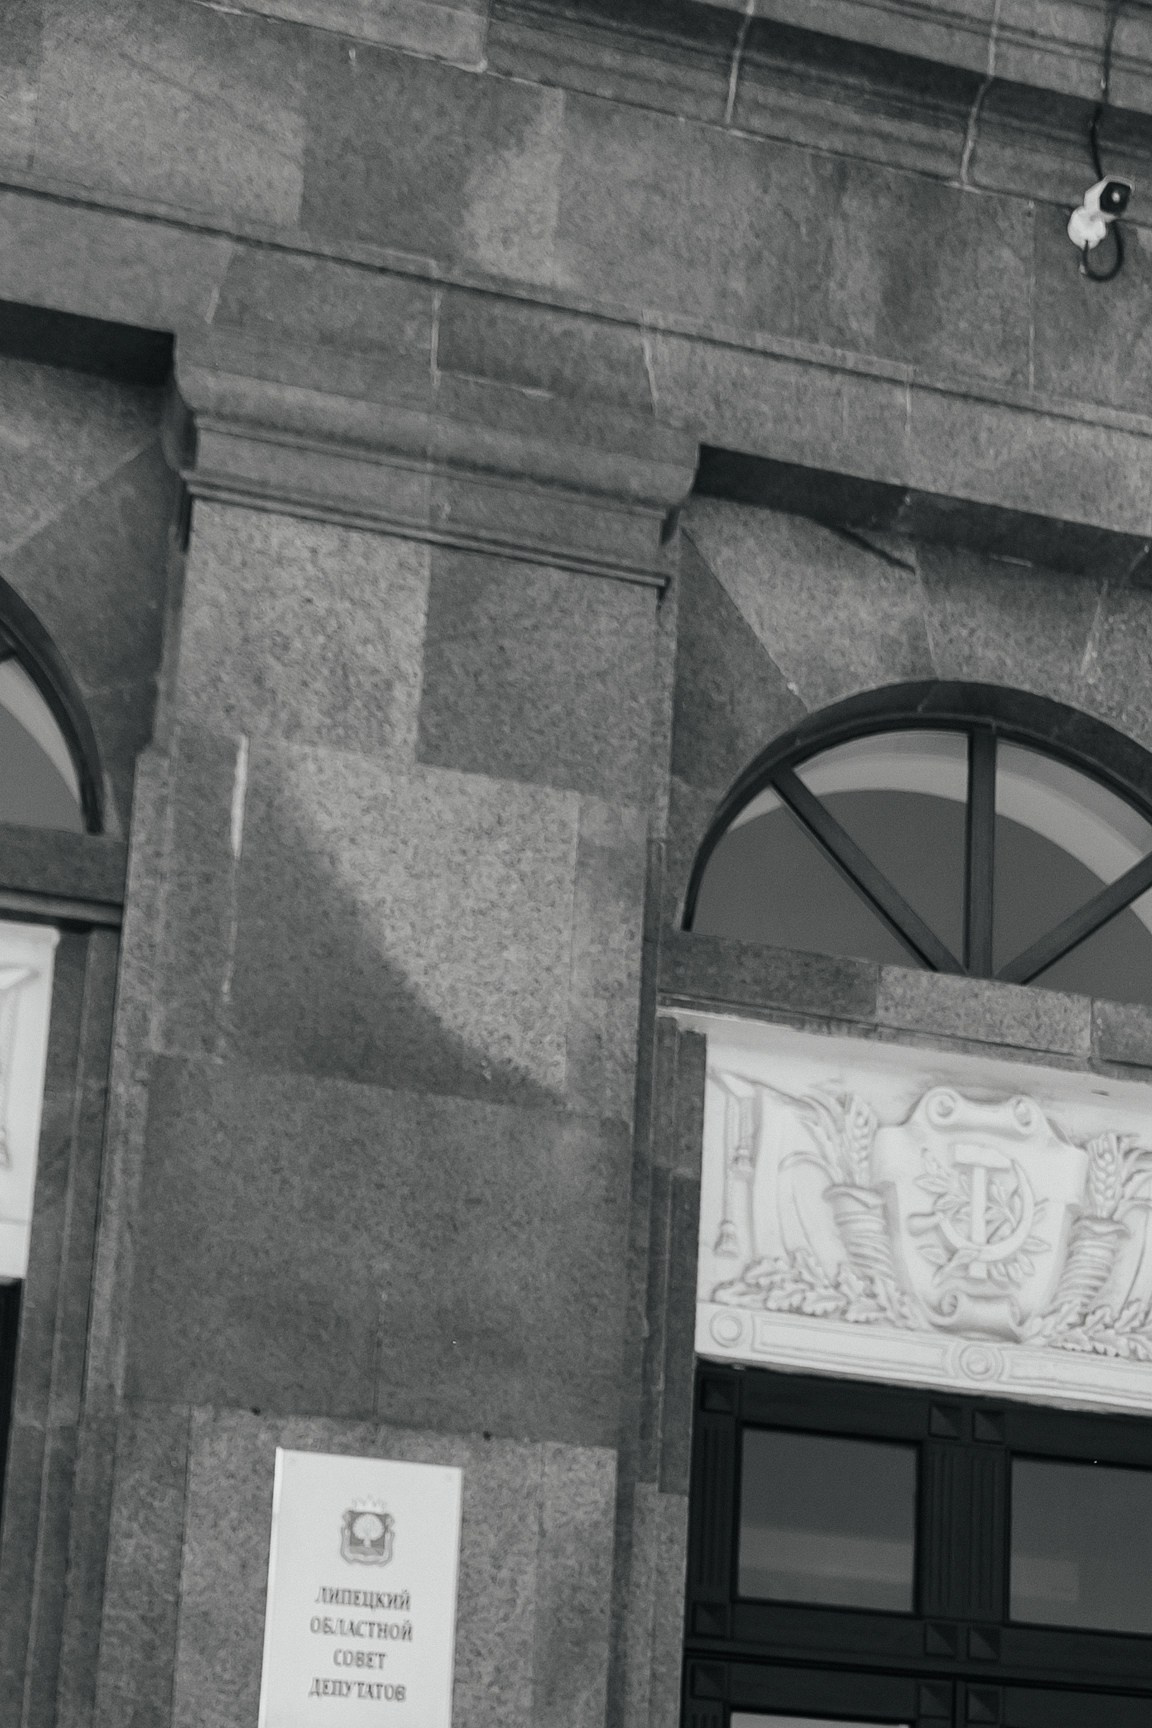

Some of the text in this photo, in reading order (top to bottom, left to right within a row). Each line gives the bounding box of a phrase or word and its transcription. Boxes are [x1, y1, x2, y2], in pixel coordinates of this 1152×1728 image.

[314, 1586, 411, 1612] ЛИПЕЦКИЙ
[310, 1616, 413, 1642] ОБЛАСТНОЙ
[333, 1648, 386, 1670] СОВЕТ
[308, 1677, 407, 1702] ДЕПУТАТОВ
